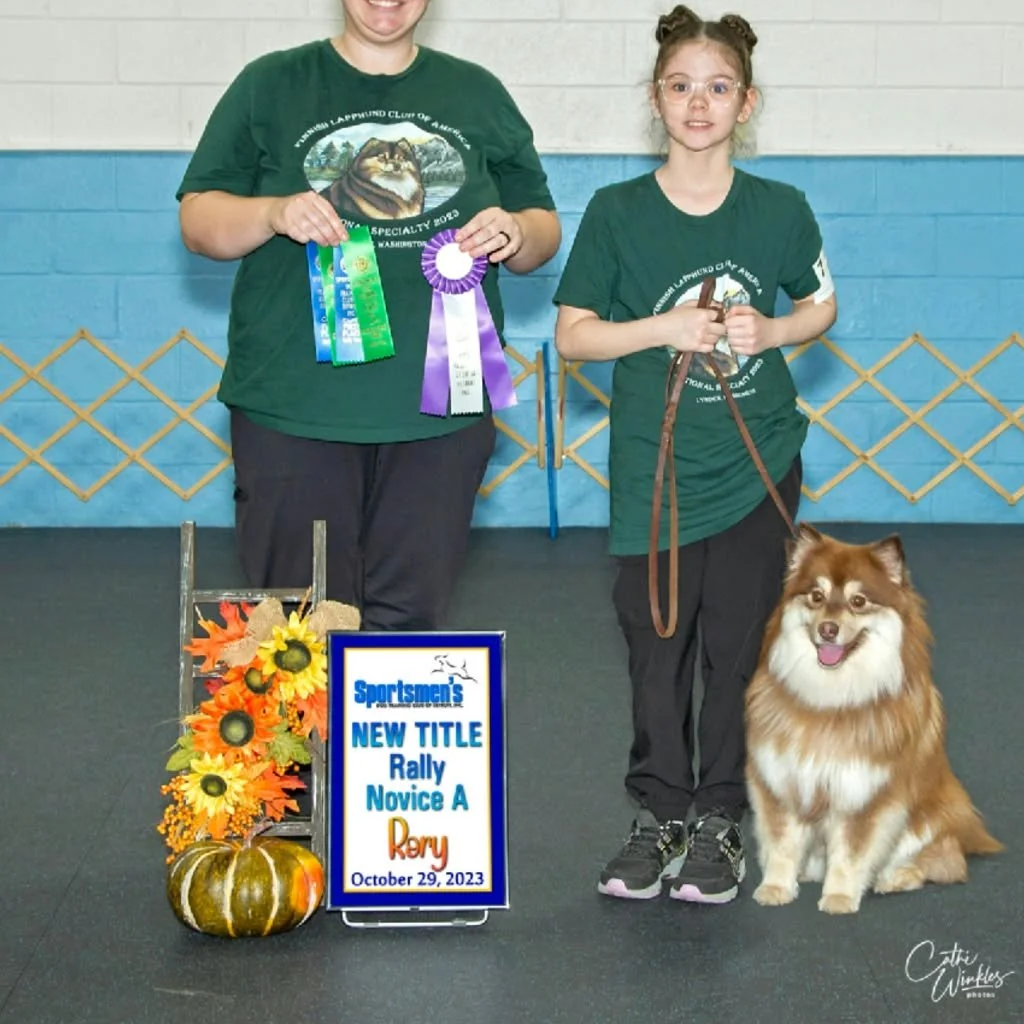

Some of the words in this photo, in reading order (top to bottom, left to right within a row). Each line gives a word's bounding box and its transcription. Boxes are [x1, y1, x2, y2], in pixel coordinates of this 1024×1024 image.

[330, 110, 386, 125] LAPPHUND
[371, 219, 431, 236] SPECIALTY
[433, 208, 460, 227] 2023
[354, 676, 464, 708] Sportsmen's
[351, 722, 406, 748] NEW
[414, 722, 483, 748] TITLE
[389, 753, 446, 785] Rally
[366, 784, 444, 812] Novice
[451, 784, 469, 811] A
[387, 816, 448, 872] Rory
[351, 871, 413, 887] October
[417, 871, 442, 888] 29,
[445, 871, 485, 886] 2023
